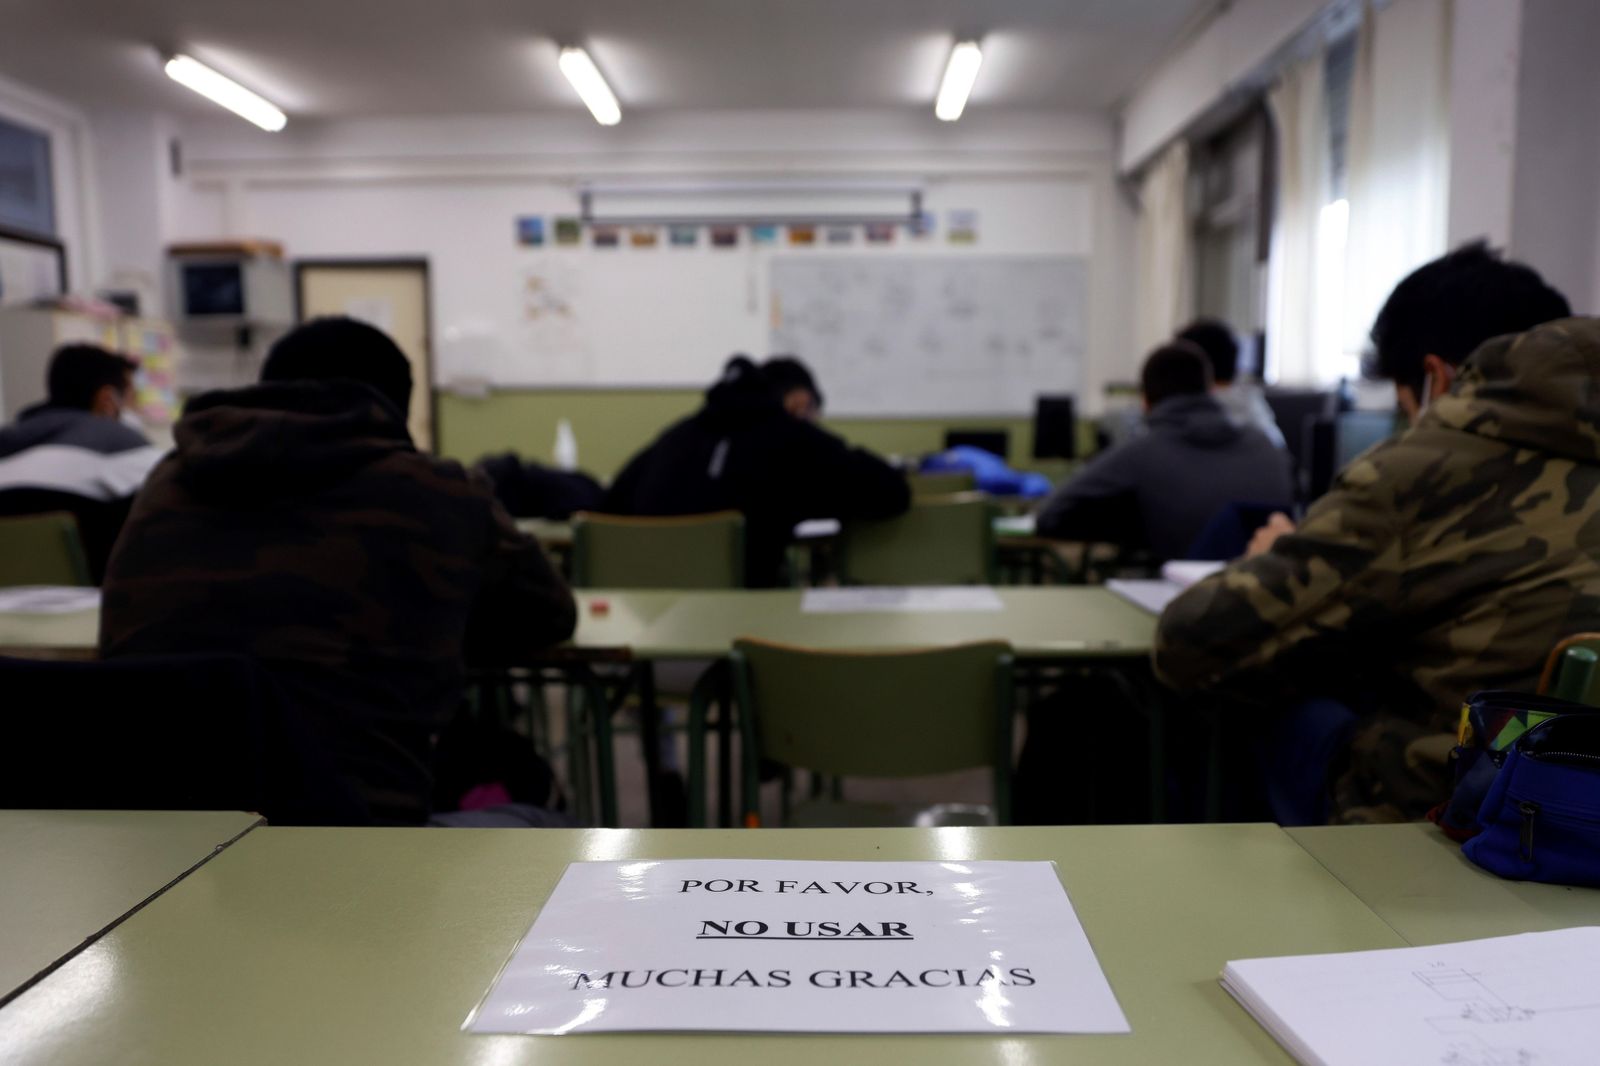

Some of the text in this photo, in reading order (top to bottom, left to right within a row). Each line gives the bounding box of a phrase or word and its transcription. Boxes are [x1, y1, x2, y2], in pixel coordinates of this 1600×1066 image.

[680, 879, 935, 896] POR FAVOR,
[700, 920, 913, 935] NO USAR
[571, 967, 1036, 989] MUCHAS GRACIAS
